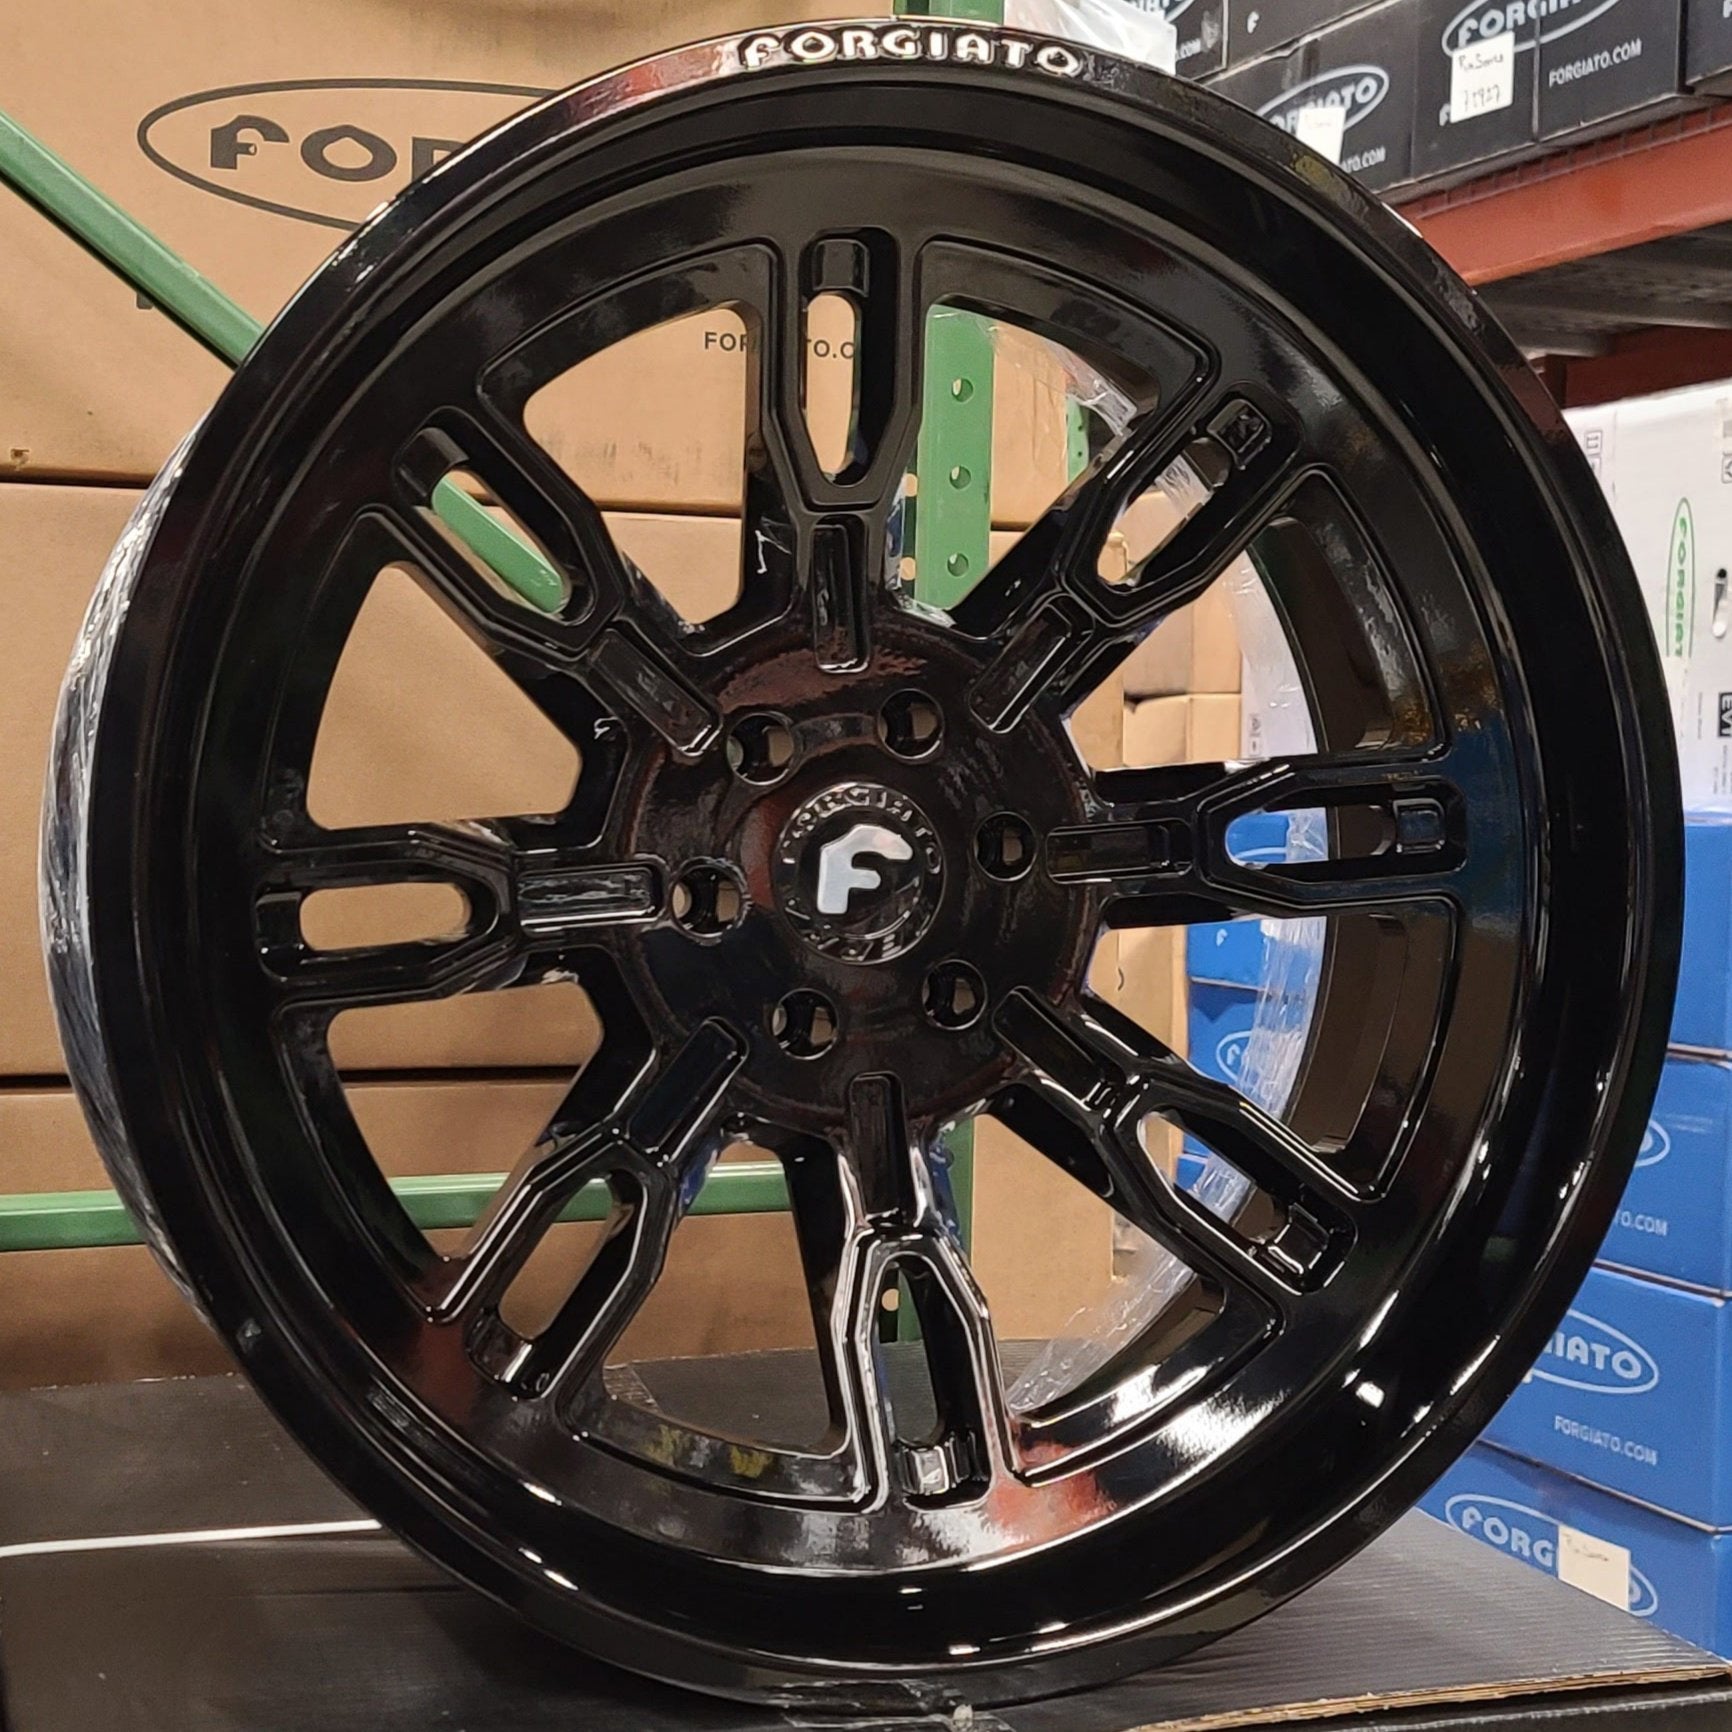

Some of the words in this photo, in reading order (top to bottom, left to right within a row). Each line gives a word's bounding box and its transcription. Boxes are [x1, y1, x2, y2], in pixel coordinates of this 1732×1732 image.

[740, 28, 1085, 78] FORGIATO
[1548, 38, 1643, 88] FORGIATO.COM
[817, 823, 914, 915] F
[1554, 1414, 1658, 1466] FORGIATO.COM
